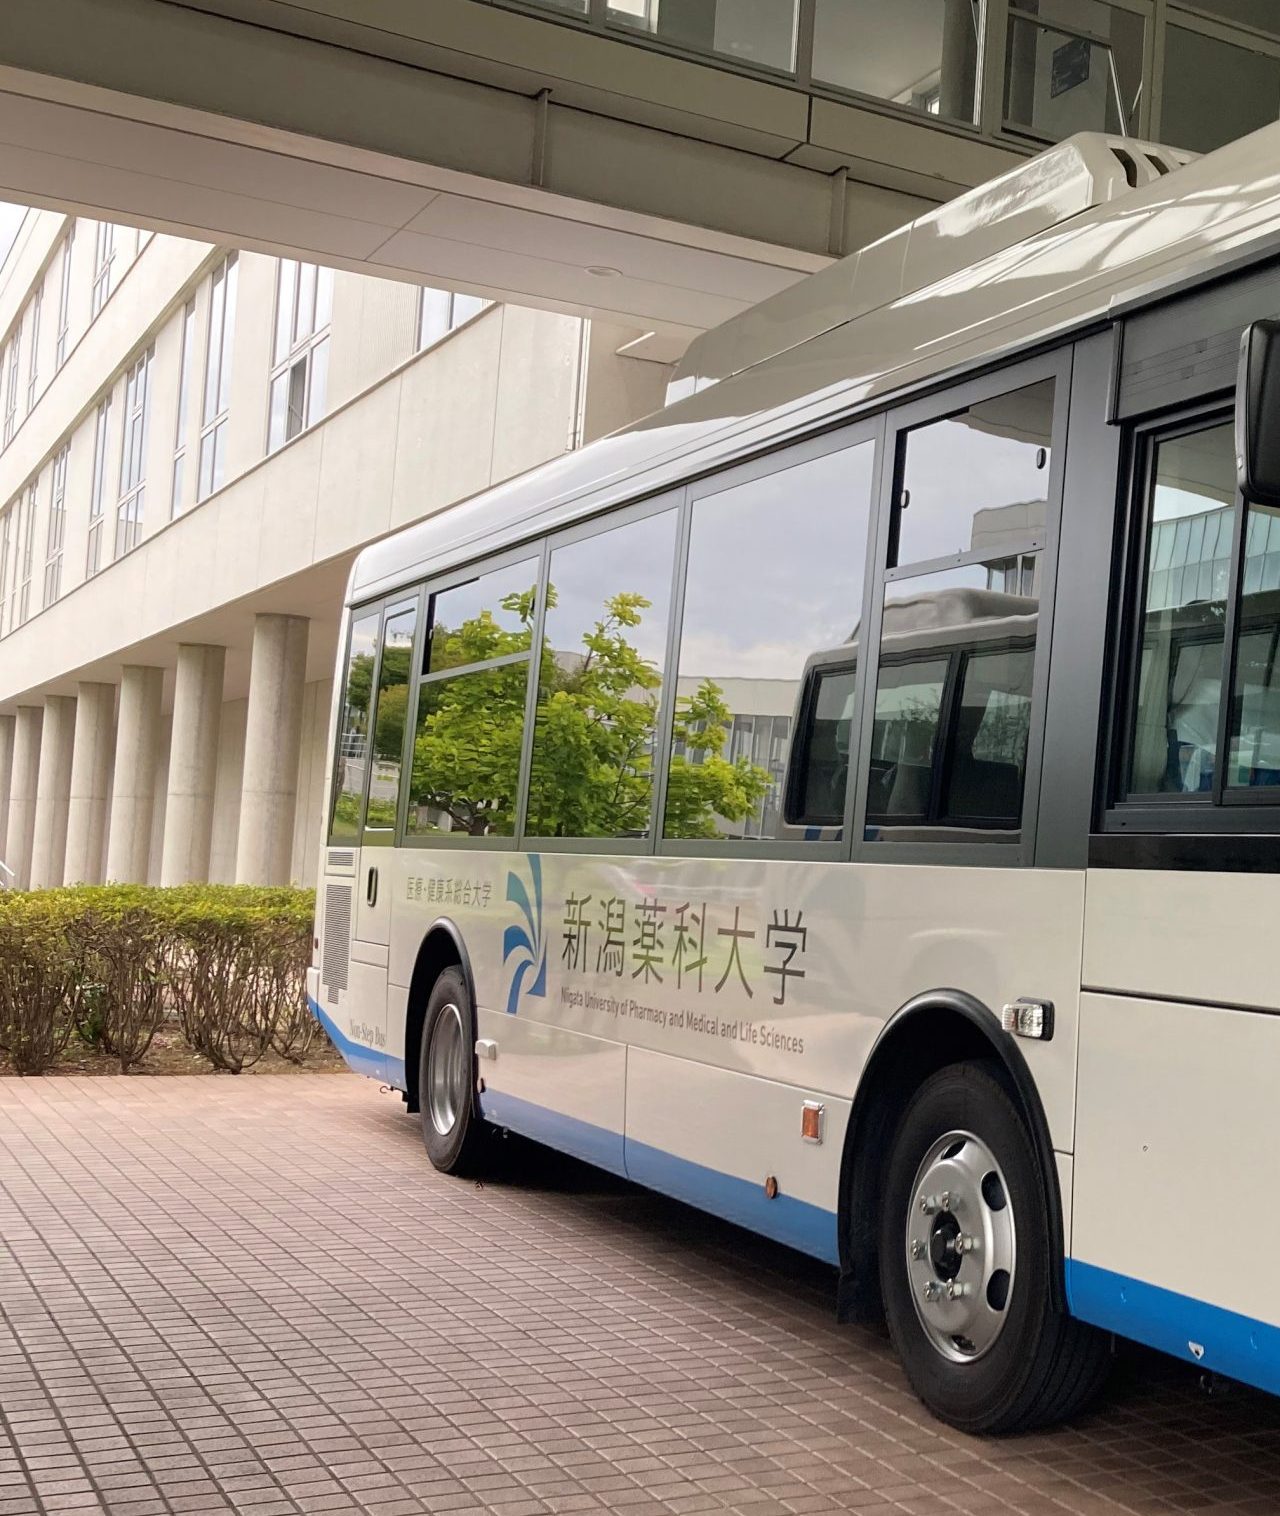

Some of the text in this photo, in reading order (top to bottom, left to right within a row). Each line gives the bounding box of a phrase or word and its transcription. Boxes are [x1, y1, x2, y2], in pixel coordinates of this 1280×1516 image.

[561, 891, 808, 1005] 新潟薬科大学
[350, 1019, 385, 1048] Non-Step Bus
[561, 986, 804, 1054] Niigata University of Pharmacy and Medical and Life Sciences
